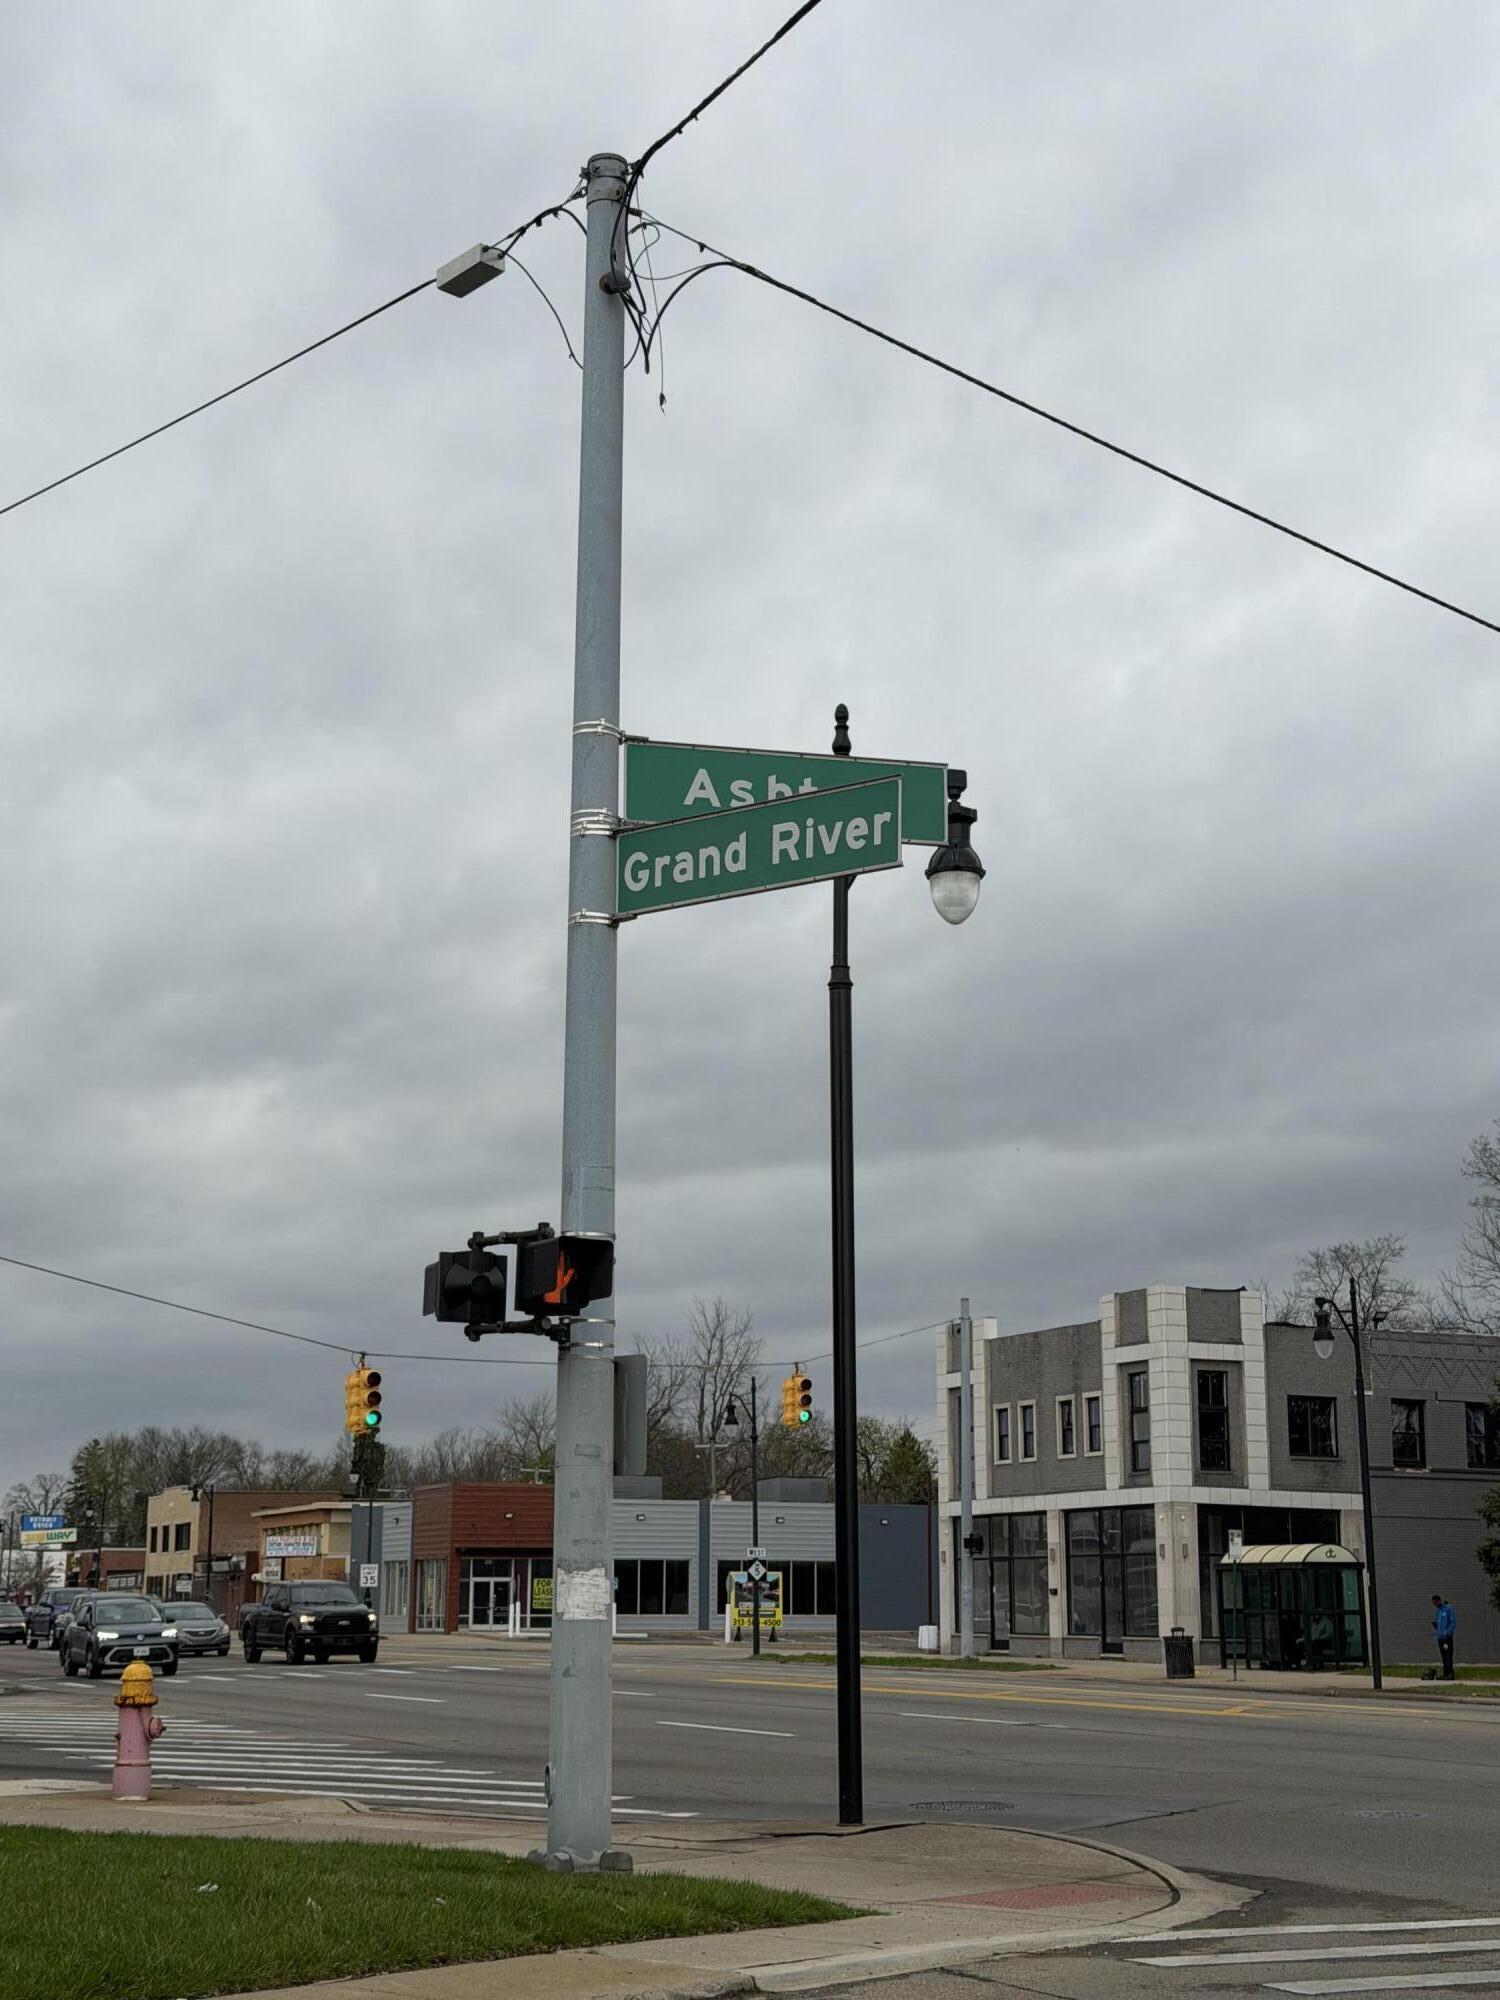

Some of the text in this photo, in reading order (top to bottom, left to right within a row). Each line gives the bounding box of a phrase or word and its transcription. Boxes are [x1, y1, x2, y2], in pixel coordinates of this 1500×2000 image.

[624, 811, 892, 892] Grand River
[362, 1575, 376, 1584] 35
